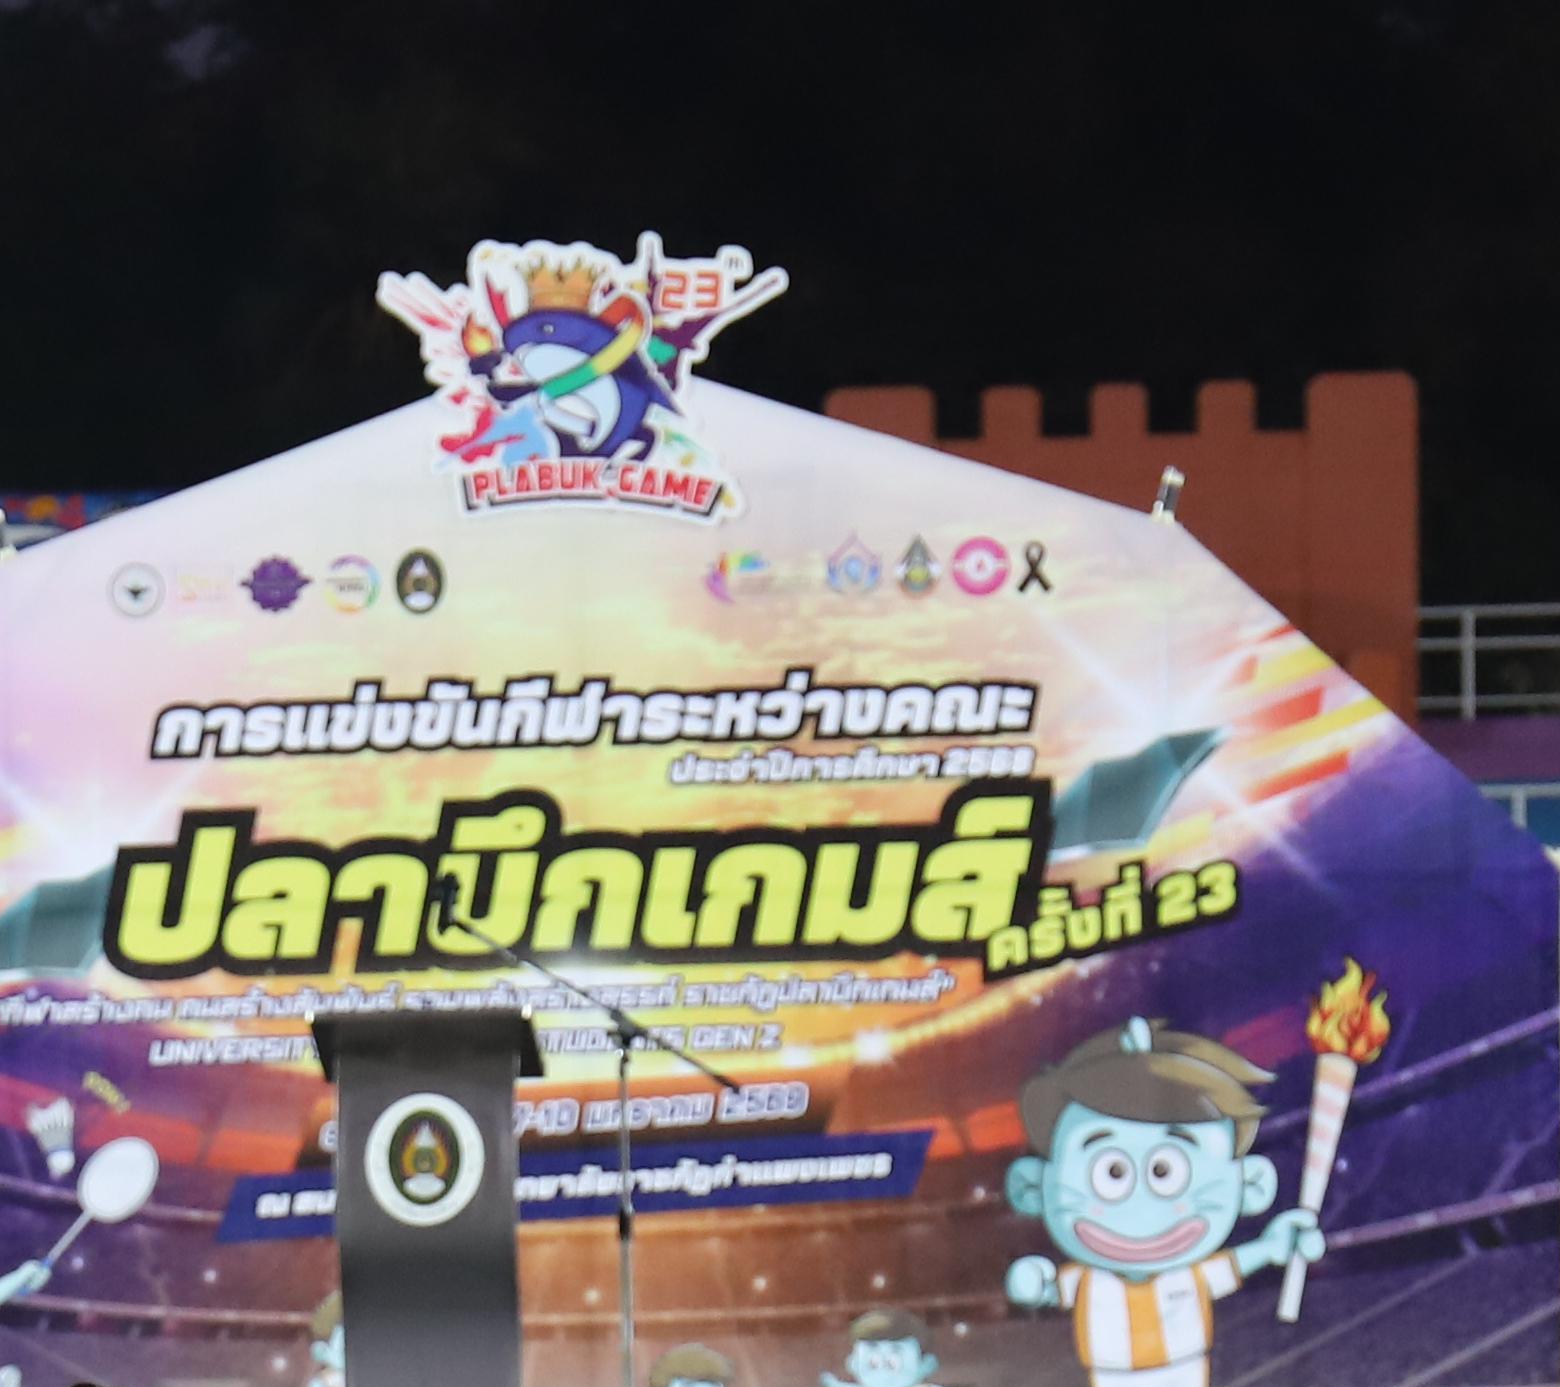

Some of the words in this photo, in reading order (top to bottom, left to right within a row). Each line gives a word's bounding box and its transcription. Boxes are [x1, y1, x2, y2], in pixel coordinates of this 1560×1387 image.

[659, 270, 723, 310] 23
[468, 460, 601, 501] PLABUK
[618, 461, 721, 507] GAME
[152, 670, 1040, 759] การแข่งขันกีฬาระหว่างคณะ
[667, 746, 941, 786] ประจำปีการศึกษา
[112, 784, 1046, 973] ปลาบึกเกมส์
[984, 861, 1145, 973] ครั้งที่
[1154, 859, 1240, 930] 23
